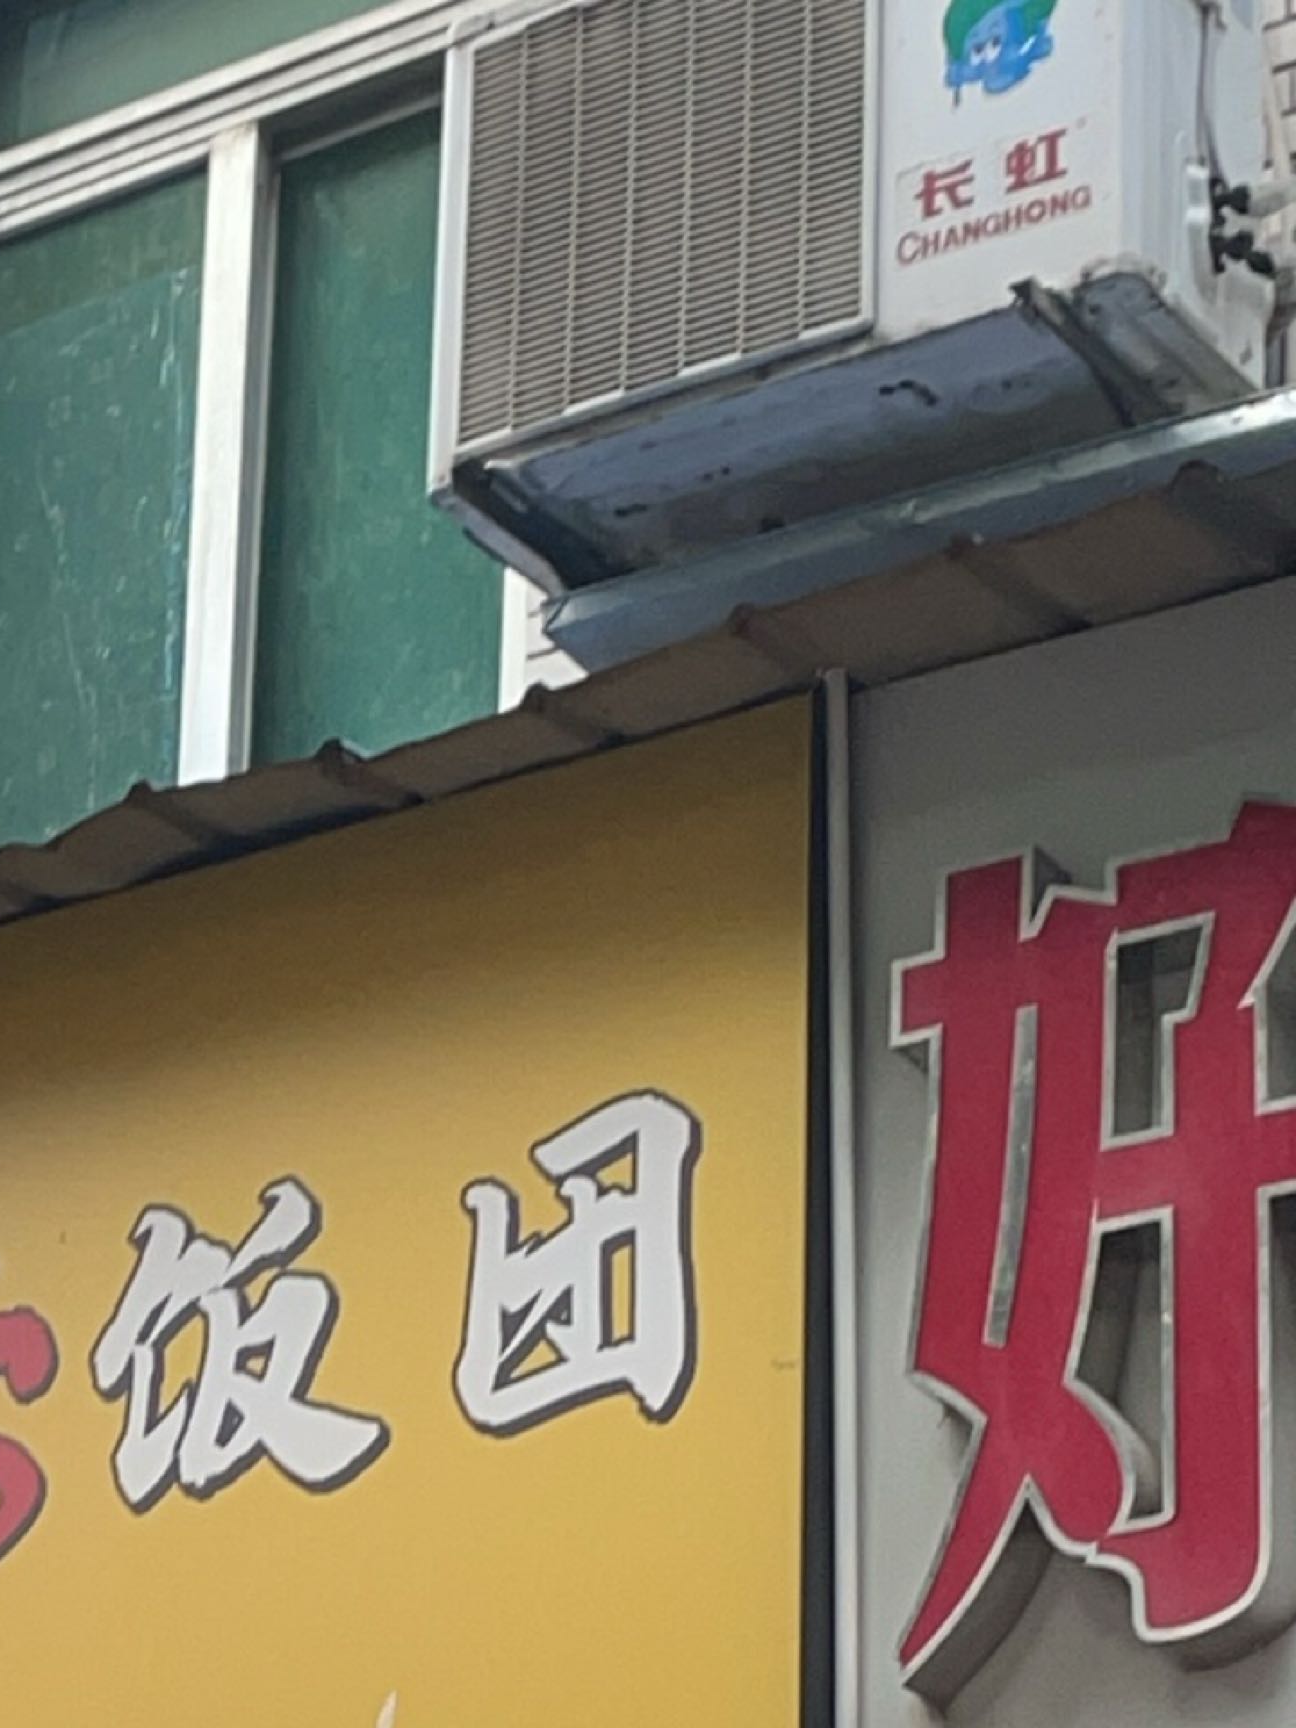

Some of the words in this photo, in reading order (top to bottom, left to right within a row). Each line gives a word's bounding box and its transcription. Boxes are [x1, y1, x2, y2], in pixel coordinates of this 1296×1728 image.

[914, 128, 1068, 220] 长虹
[896, 184, 1093, 267] CHANGHONG
[894, 803, 1296, 1645] 好
